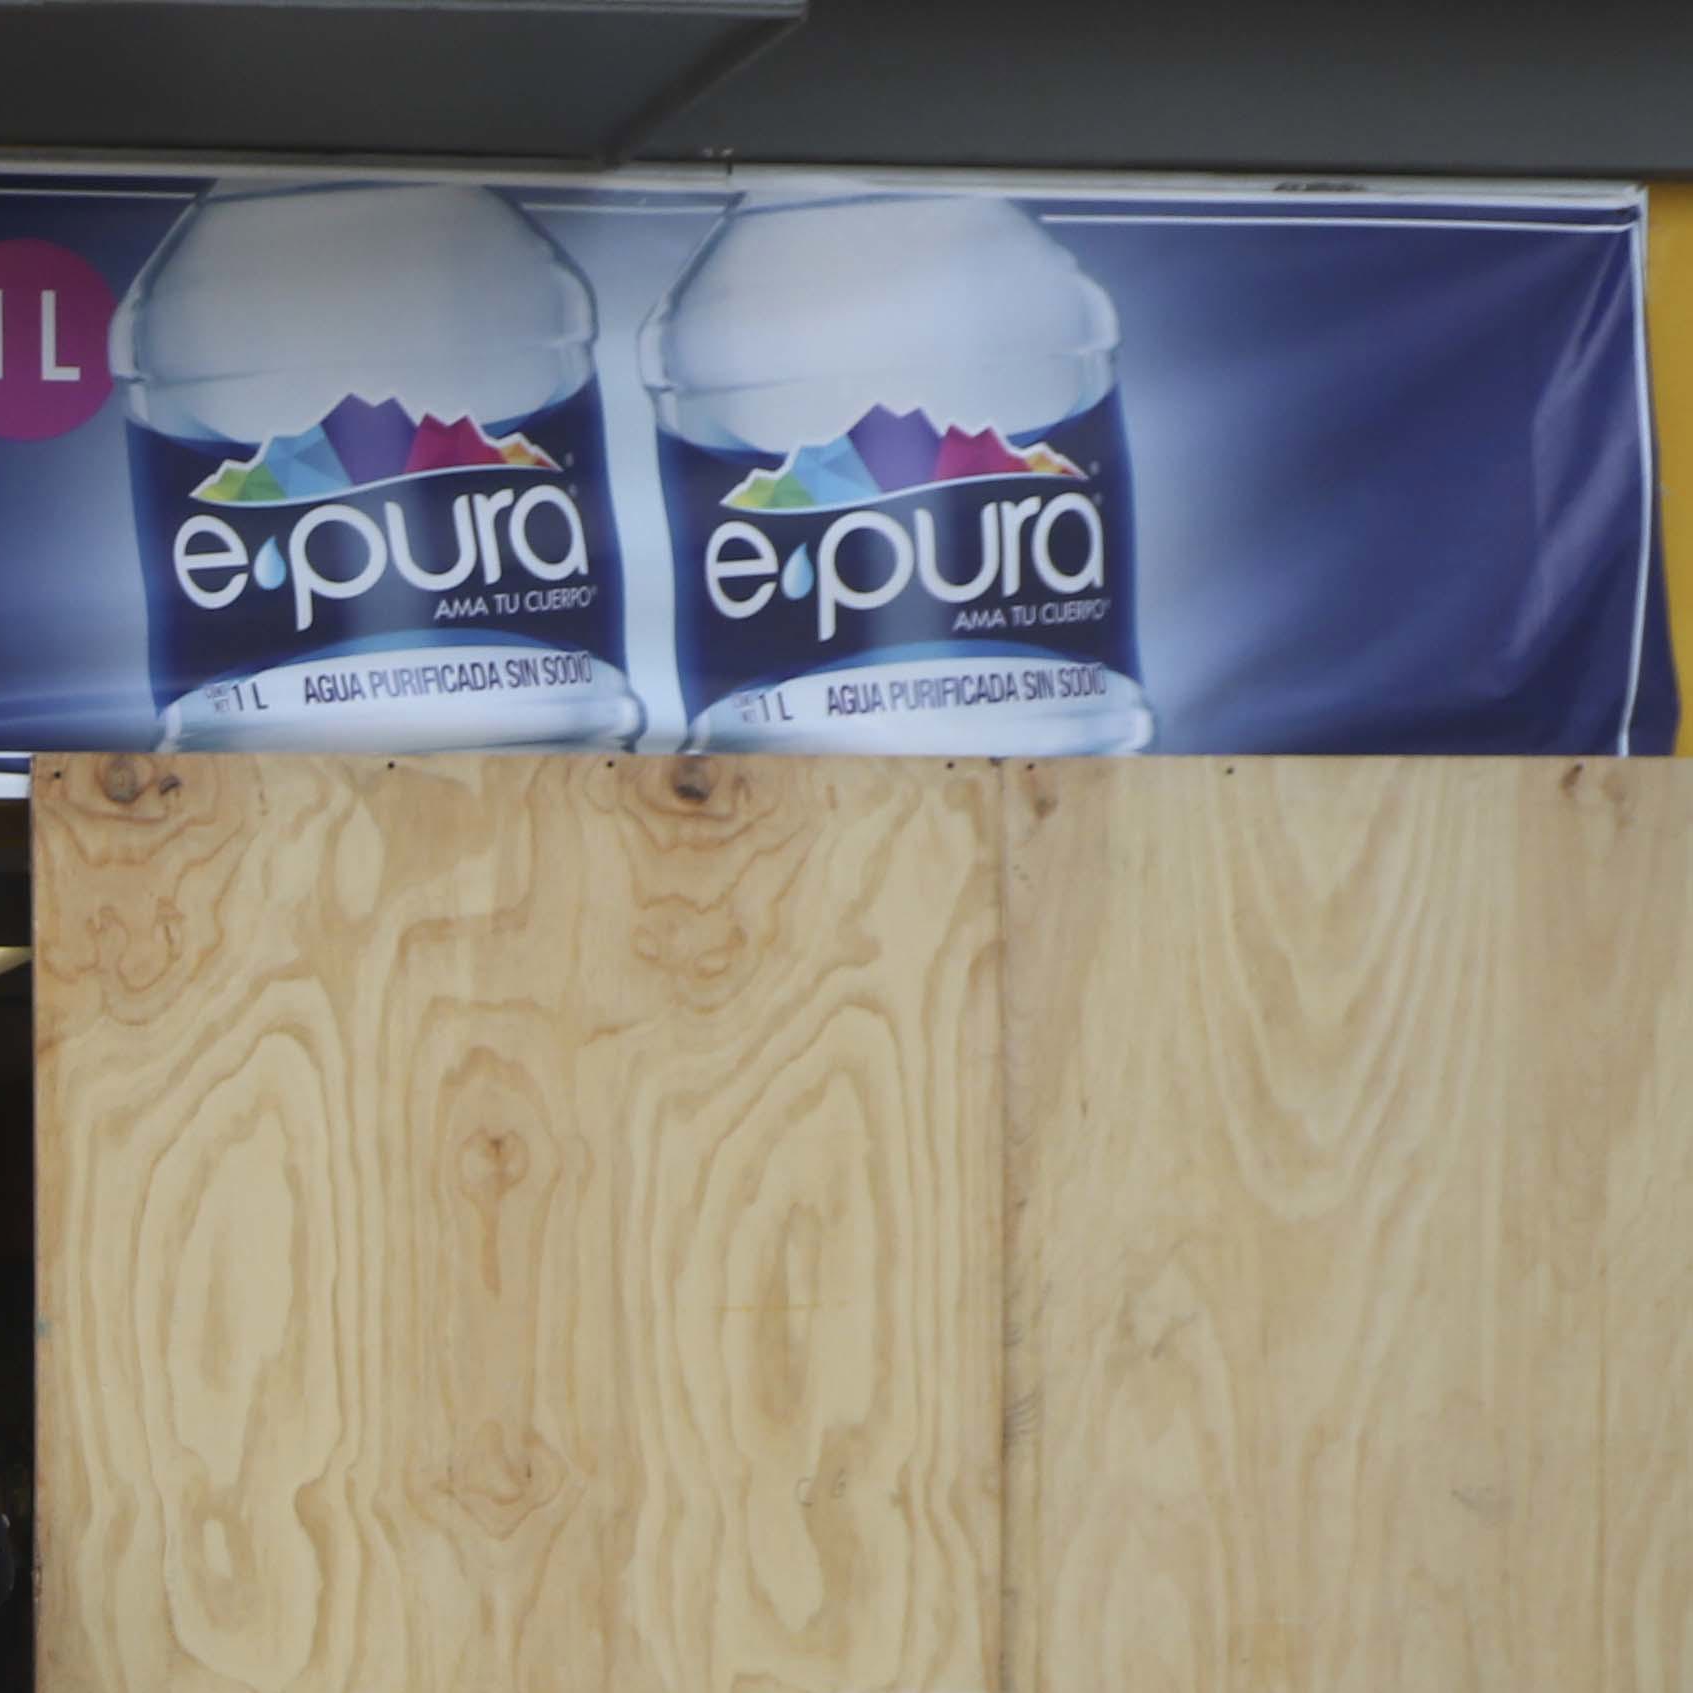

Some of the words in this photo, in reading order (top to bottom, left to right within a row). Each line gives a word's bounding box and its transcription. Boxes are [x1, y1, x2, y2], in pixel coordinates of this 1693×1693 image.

[41, 289, 82, 382] L
[434, 599, 489, 621] AMA
[494, 595, 522, 613] TU
[952, 607, 1007, 632] AMA
[1011, 604, 1037, 625] TU
[304, 674, 363, 706] AGUA
[369, 661, 503, 699] PURIFICADA
[507, 657, 536, 689] SIN
[544, 651, 593, 686] SODIO
[827, 684, 886, 717] AGUA
[891, 672, 1017, 711] PURIFICADA
[1022, 669, 1054, 700] SIN
[1060, 663, 1108, 697] SODIO
[231, 685, 244, 712] 1
[253, 683, 269, 712] L
[758, 696, 771, 723] 1
[778, 694, 794, 721] L
